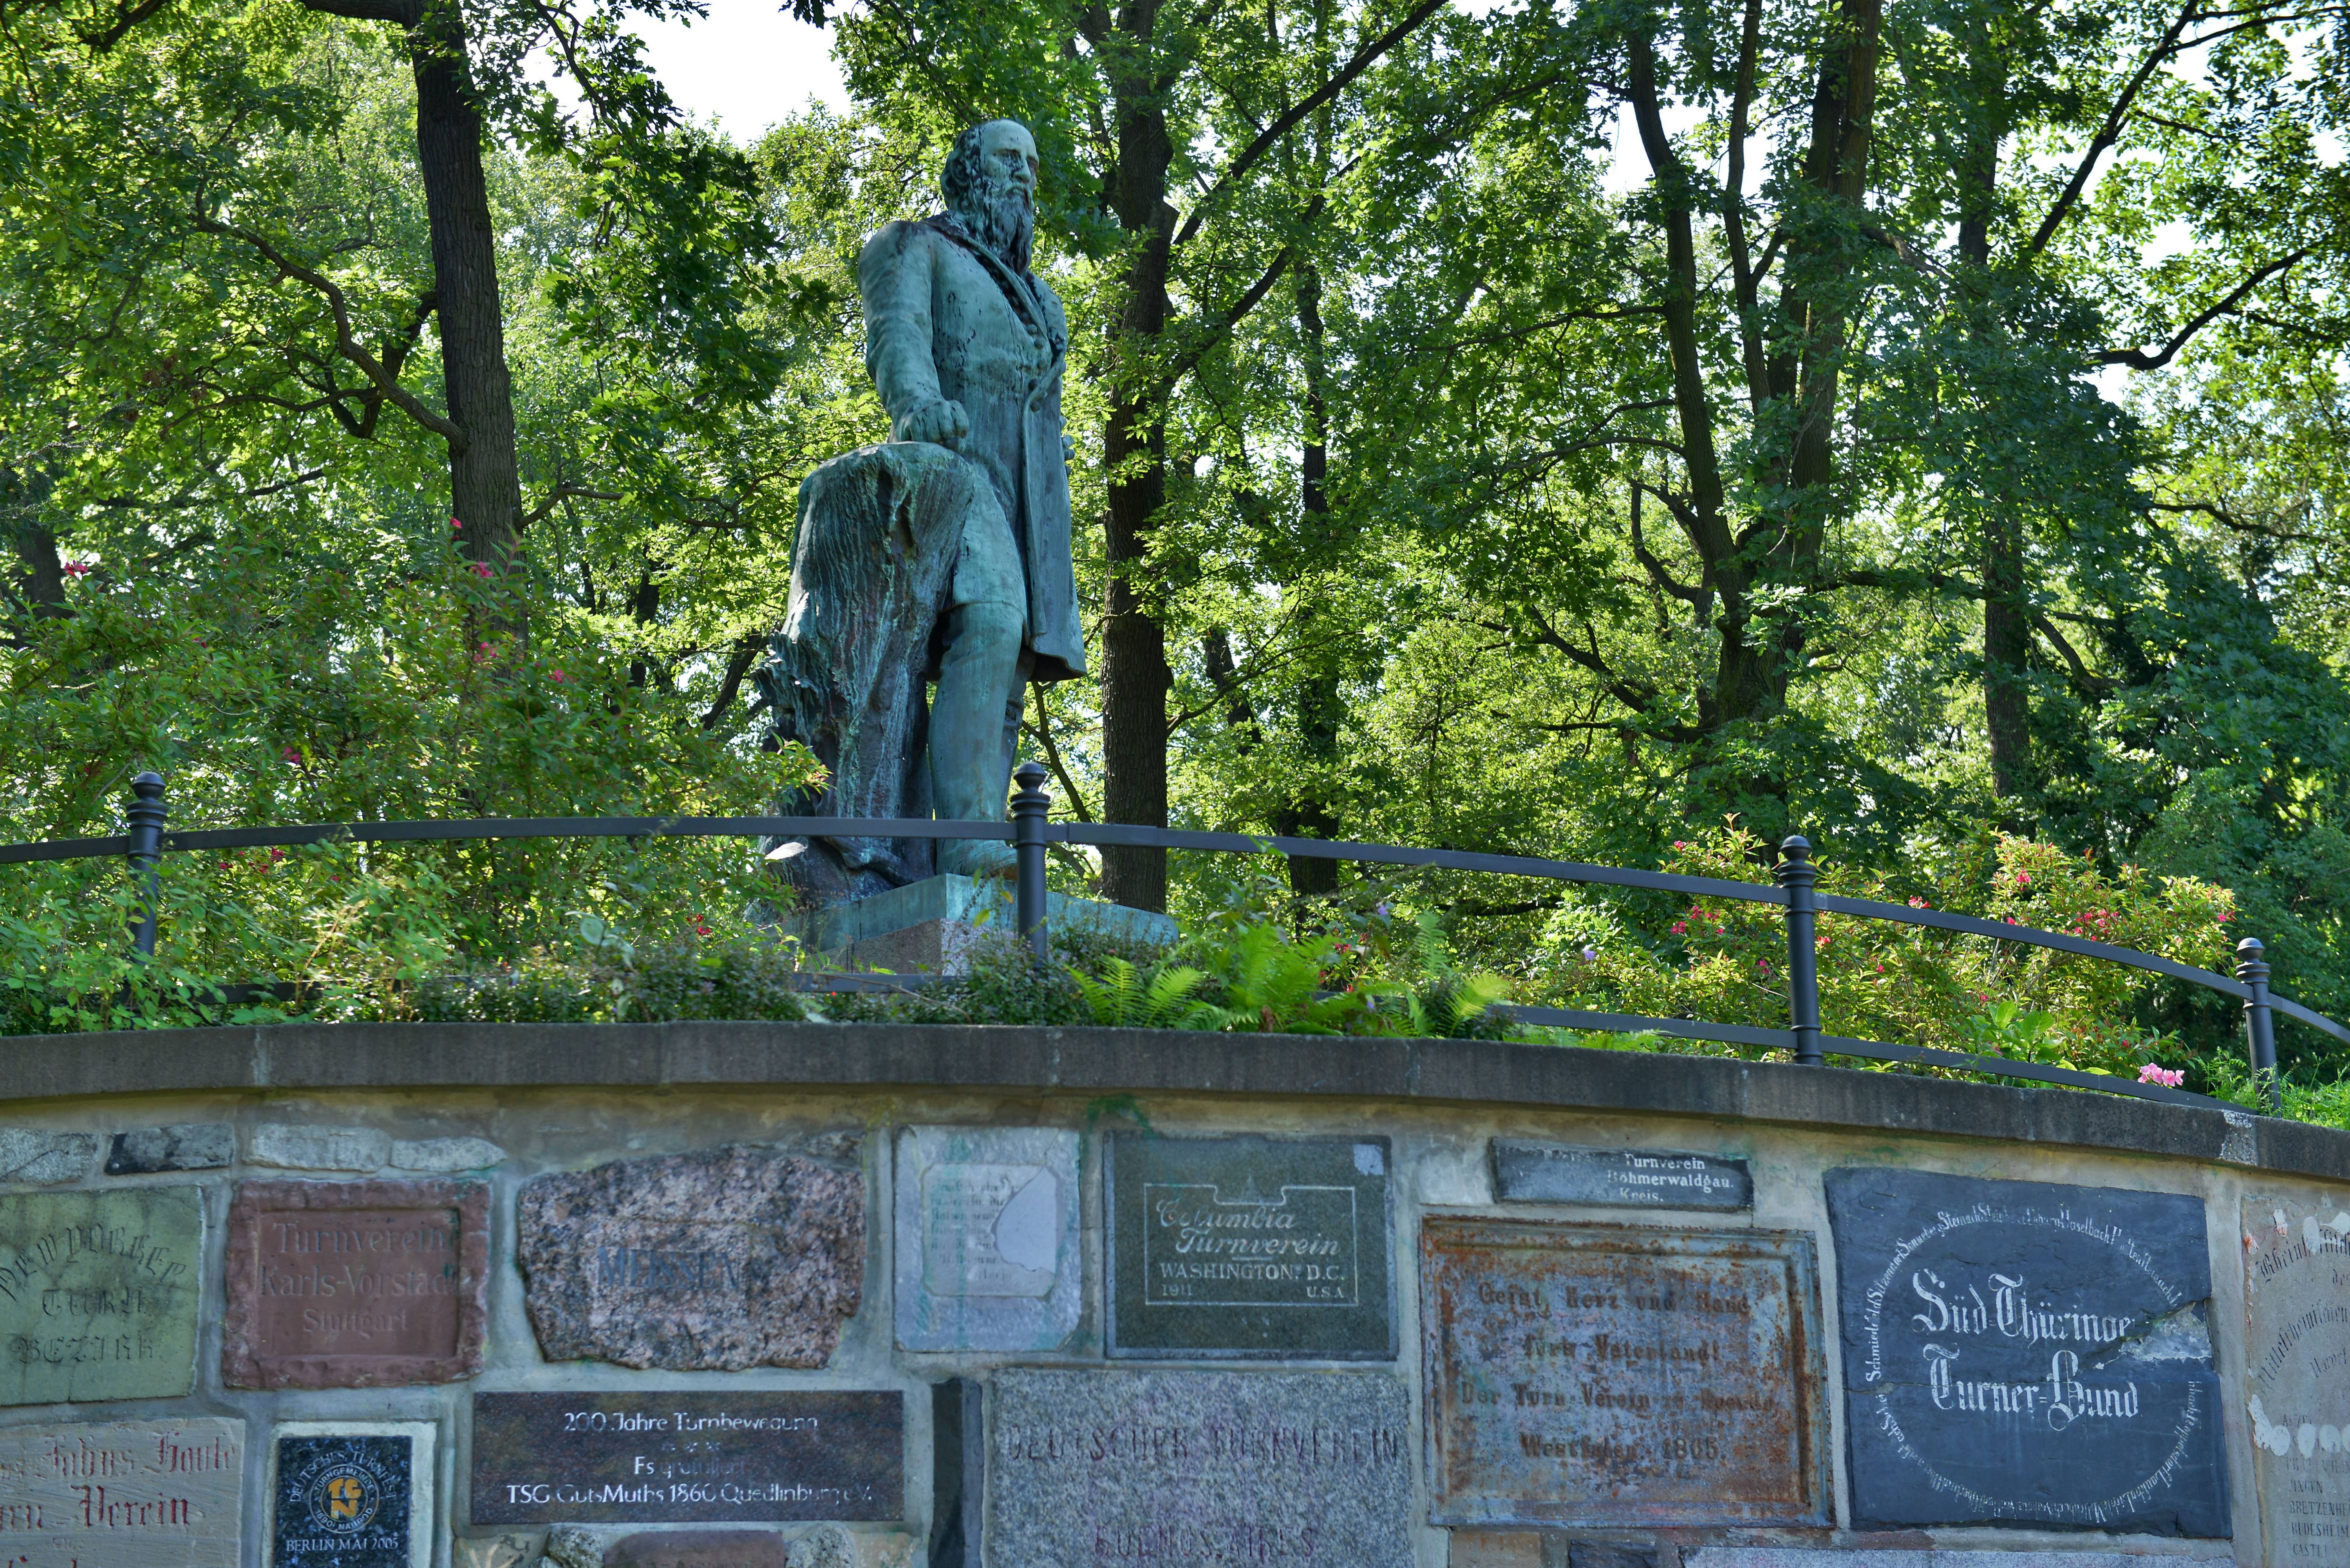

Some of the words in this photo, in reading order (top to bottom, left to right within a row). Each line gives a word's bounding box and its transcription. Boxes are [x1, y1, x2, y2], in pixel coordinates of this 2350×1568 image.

[1624, 1151, 1705, 1170] Turnverein
[1620, 1187, 1664, 1202] Kreis.
[1156, 1198, 1296, 1229] Columbia
[274, 1222, 445, 1253] Turnverein
[1175, 1227, 1339, 1255] Turnverein
[598, 1246, 739, 1290] MEISSEN
[1162, 1283, 1192, 1297] 1911
[304, 1308, 409, 1340] Stuttgart
[564, 1411, 607, 1432] 200
[611, 1412, 668, 1431] Jahre
[673, 1412, 818, 1436] Turnbewegung
[1007, 1423, 1188, 1461] DEUTSCHER
[1212, 1425, 1397, 1462] TURNVEREIN
[290, 1450, 345, 1503] DEUTSCHES
[352, 1450, 397, 1501] TURNFEST
[314, 1468, 375, 1492] TURNGEMEINDE
[506, 1484, 550, 1504] TSG
[556, 1483, 664, 1503] GutsMuths
[669, 1483, 716, 1503] 1860
[721, 1482, 840, 1505] Quedlinburg
[338, 1508, 373, 1530] NAUROD
[286, 1539, 334, 1552] BERLIN
[338, 1538, 367, 1550] MAI
[372, 1537, 399, 1549] 2005
